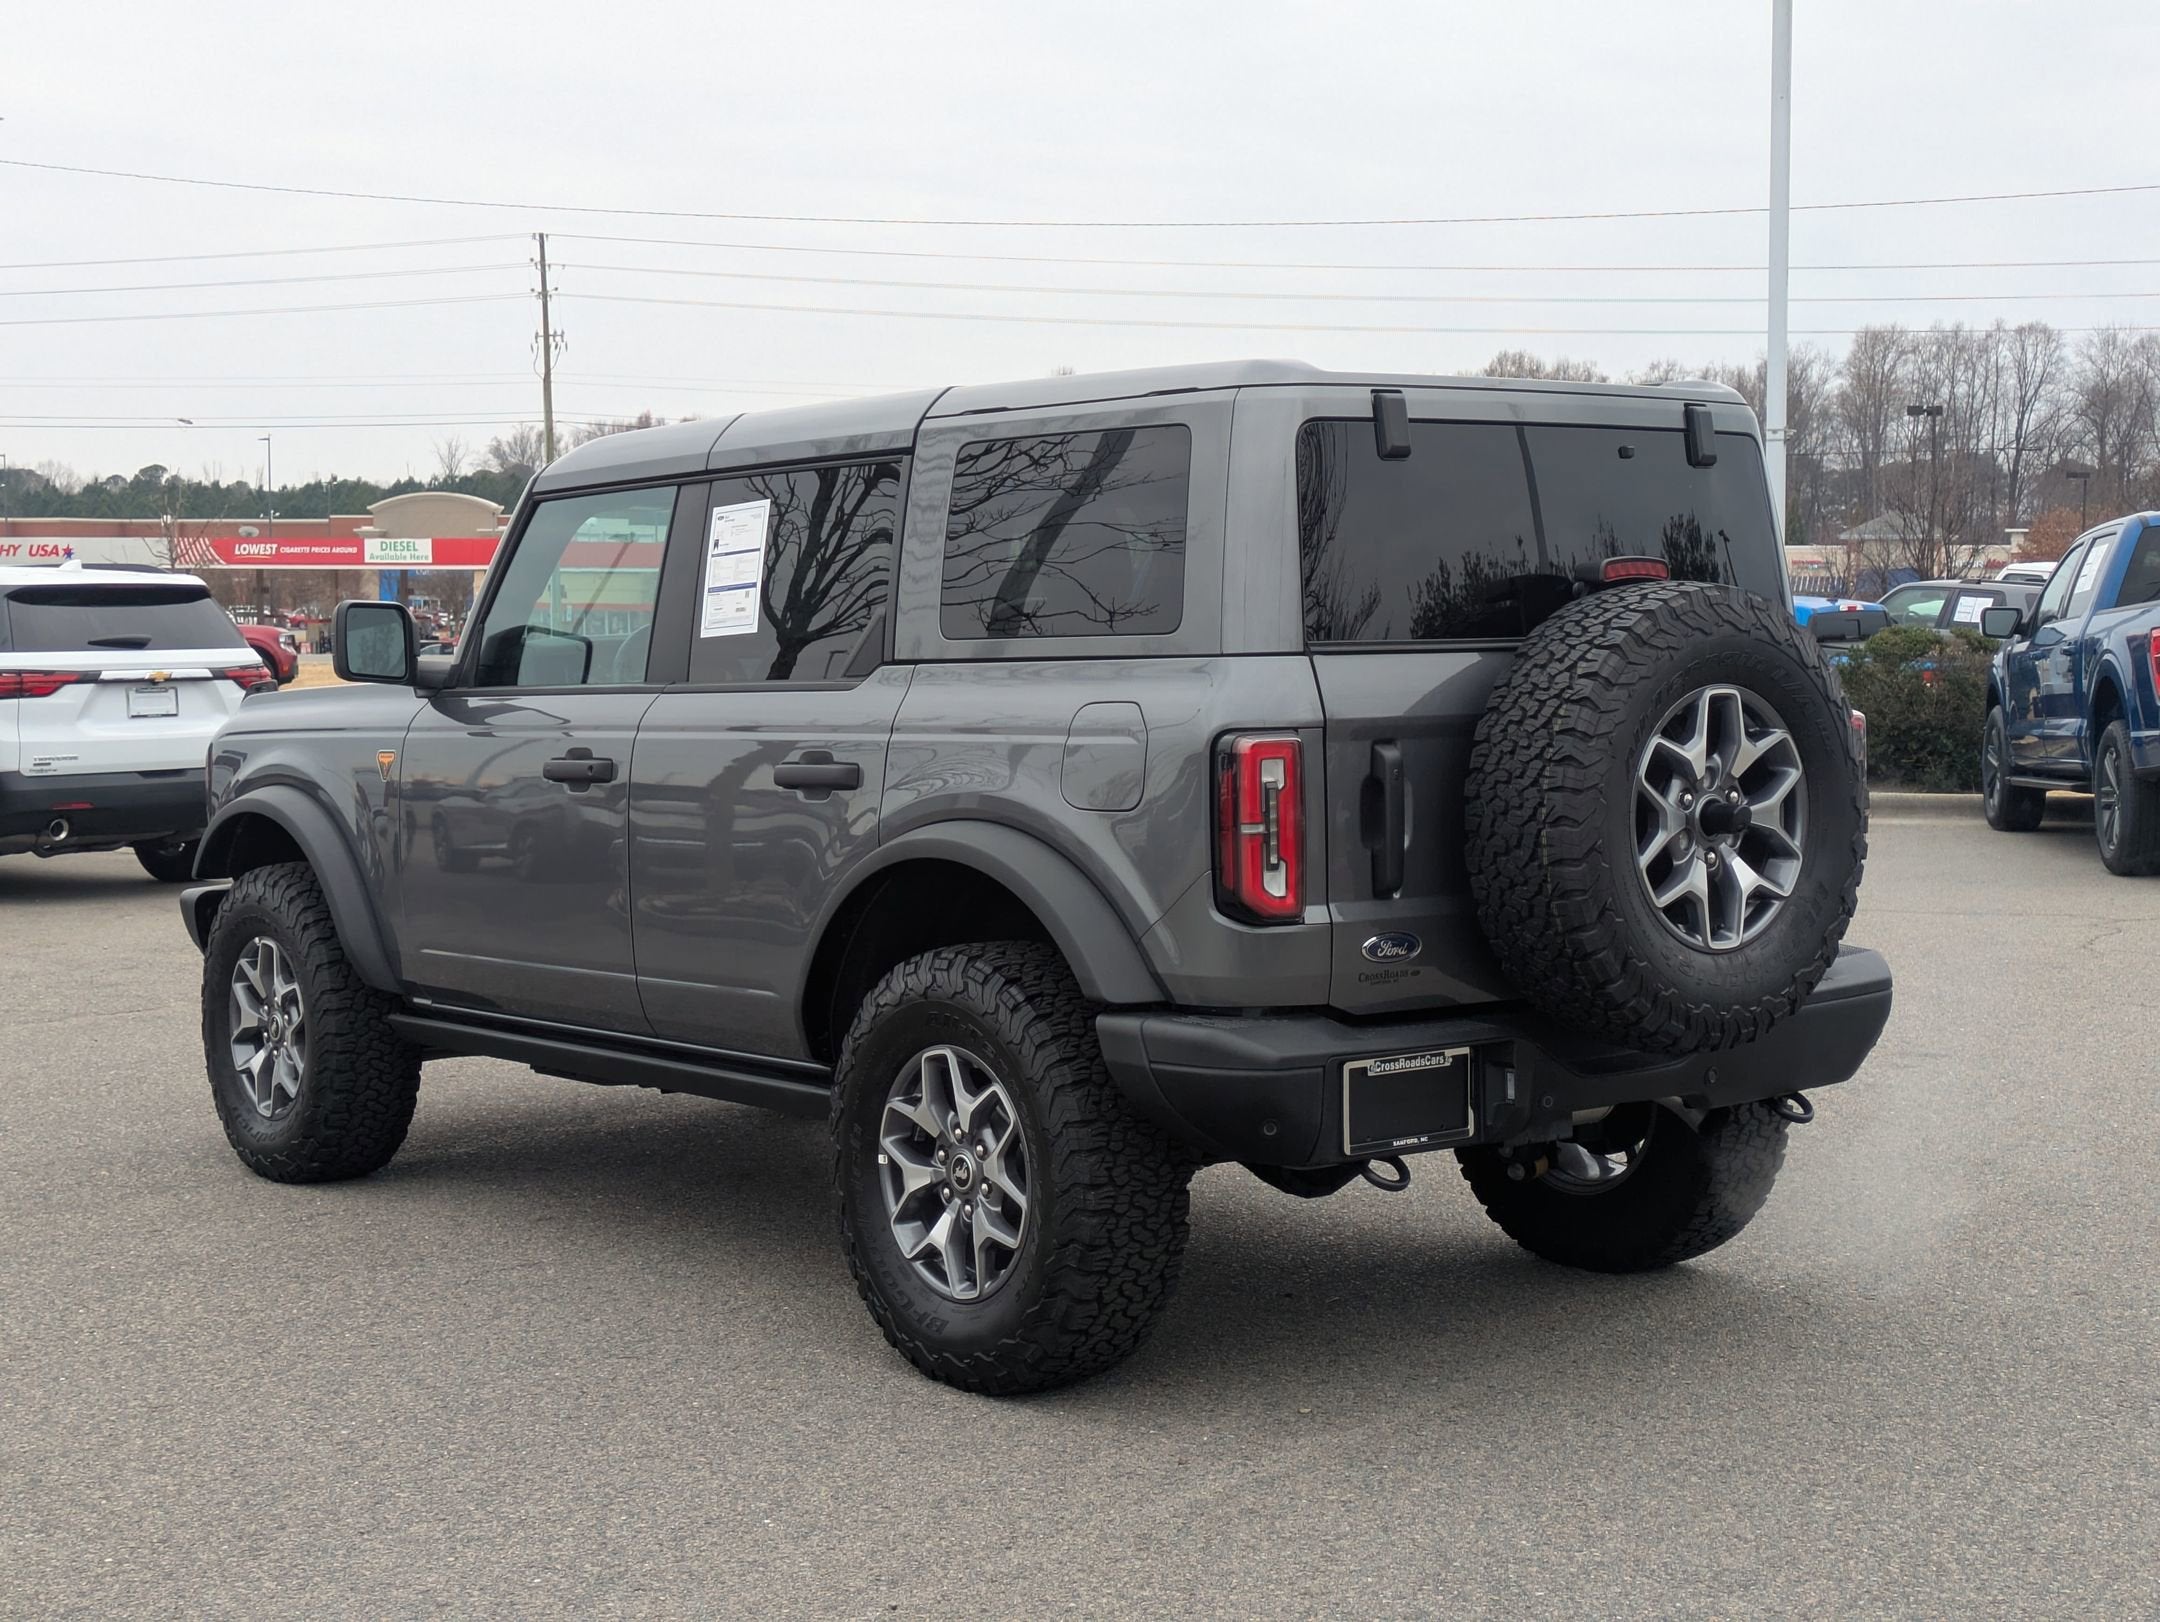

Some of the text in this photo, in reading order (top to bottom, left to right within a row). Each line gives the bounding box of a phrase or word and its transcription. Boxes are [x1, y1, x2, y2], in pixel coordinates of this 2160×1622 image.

[28, 544, 60, 557] USA
[234, 543, 278, 555] LOWEST
[380, 541, 419, 552] DIESEL
[369, 552, 429, 561] Available Here
[1377, 940, 1409, 957] Ford
[1375, 1055, 1444, 1072] CrossRoadsCars
